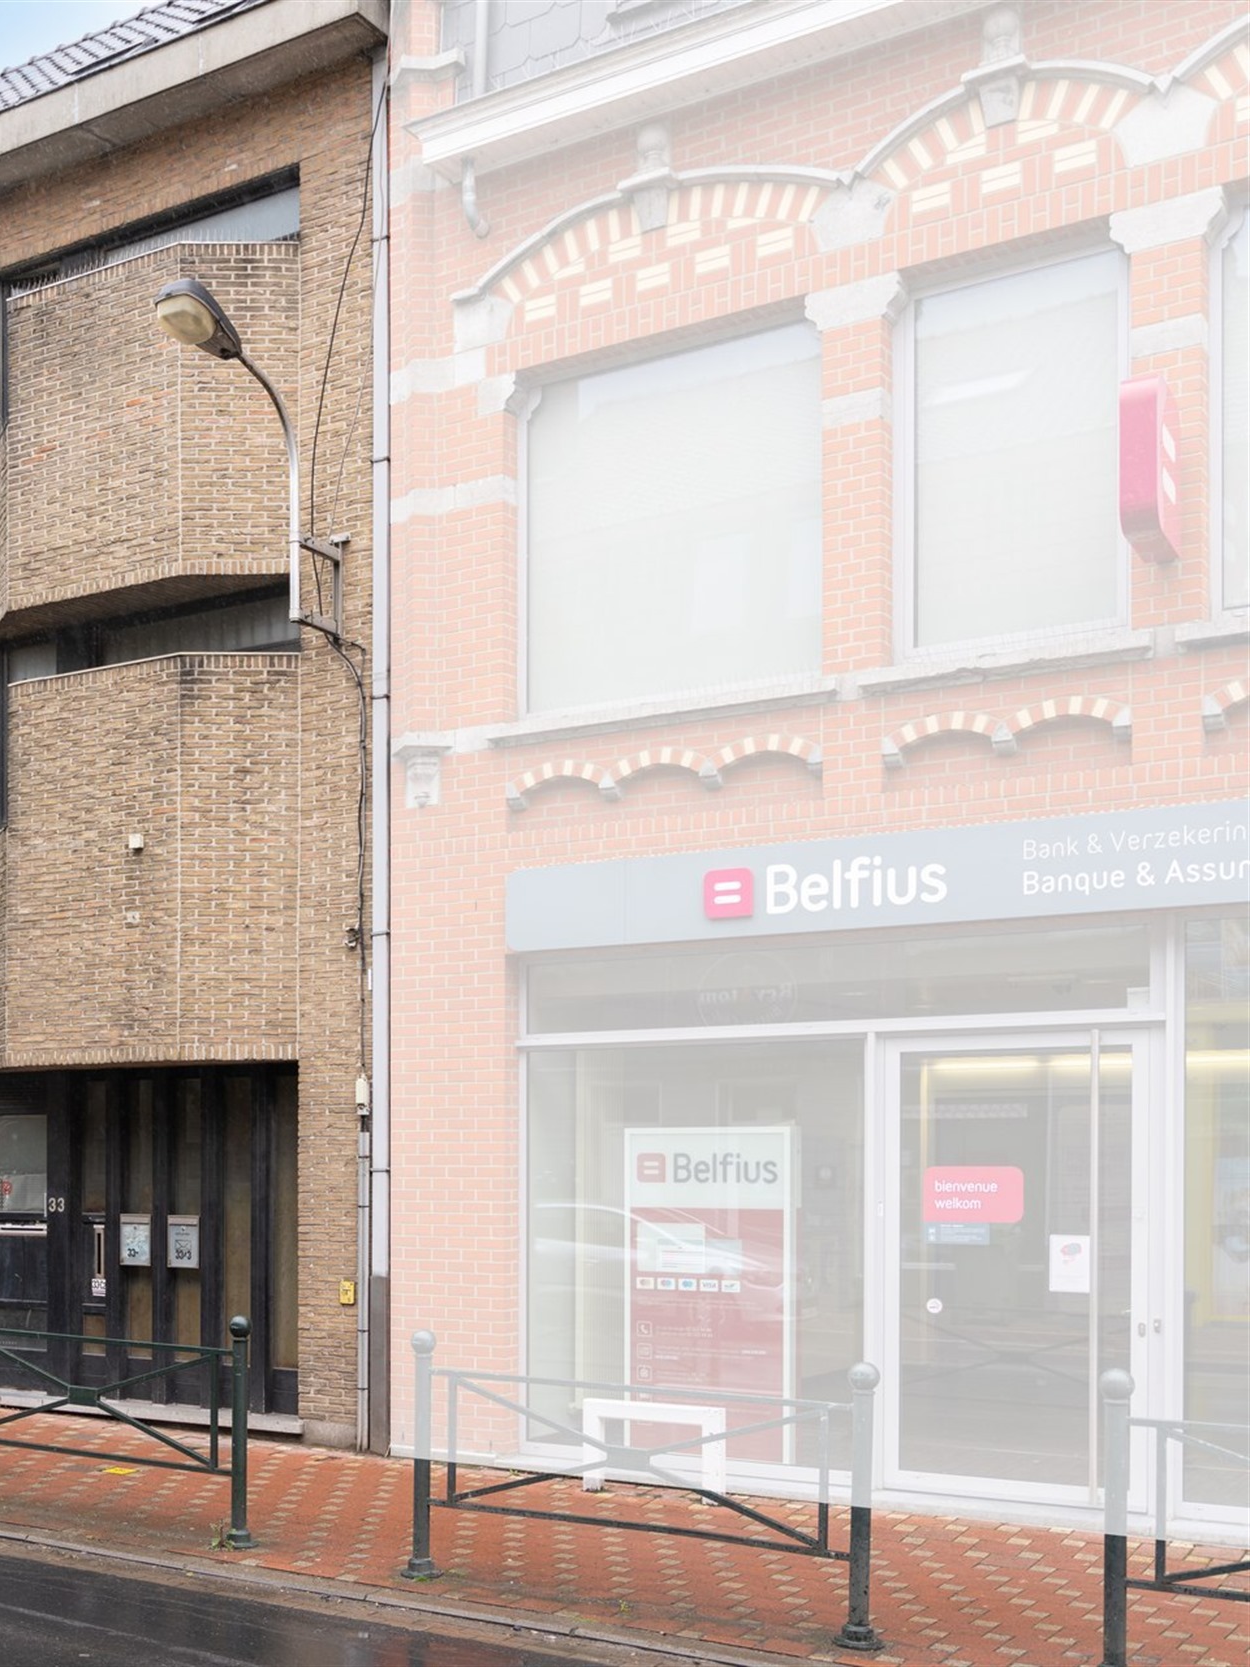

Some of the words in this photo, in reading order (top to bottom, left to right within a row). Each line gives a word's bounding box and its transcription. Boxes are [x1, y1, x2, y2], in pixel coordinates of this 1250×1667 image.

[1022, 836, 1079, 860] Bank
[1087, 832, 1103, 854] &
[1109, 820, 1246, 852] Verzekerin
[766, 855, 948, 915] Belfius
[1022, 869, 1126, 896] Banque
[1136, 860, 1155, 886] &
[672, 1152, 778, 1184] Belfius
[934, 1180, 998, 1193] bienvenue
[48, 1197, 65, 1213] 33
[934, 1197, 982, 1210] welkom
